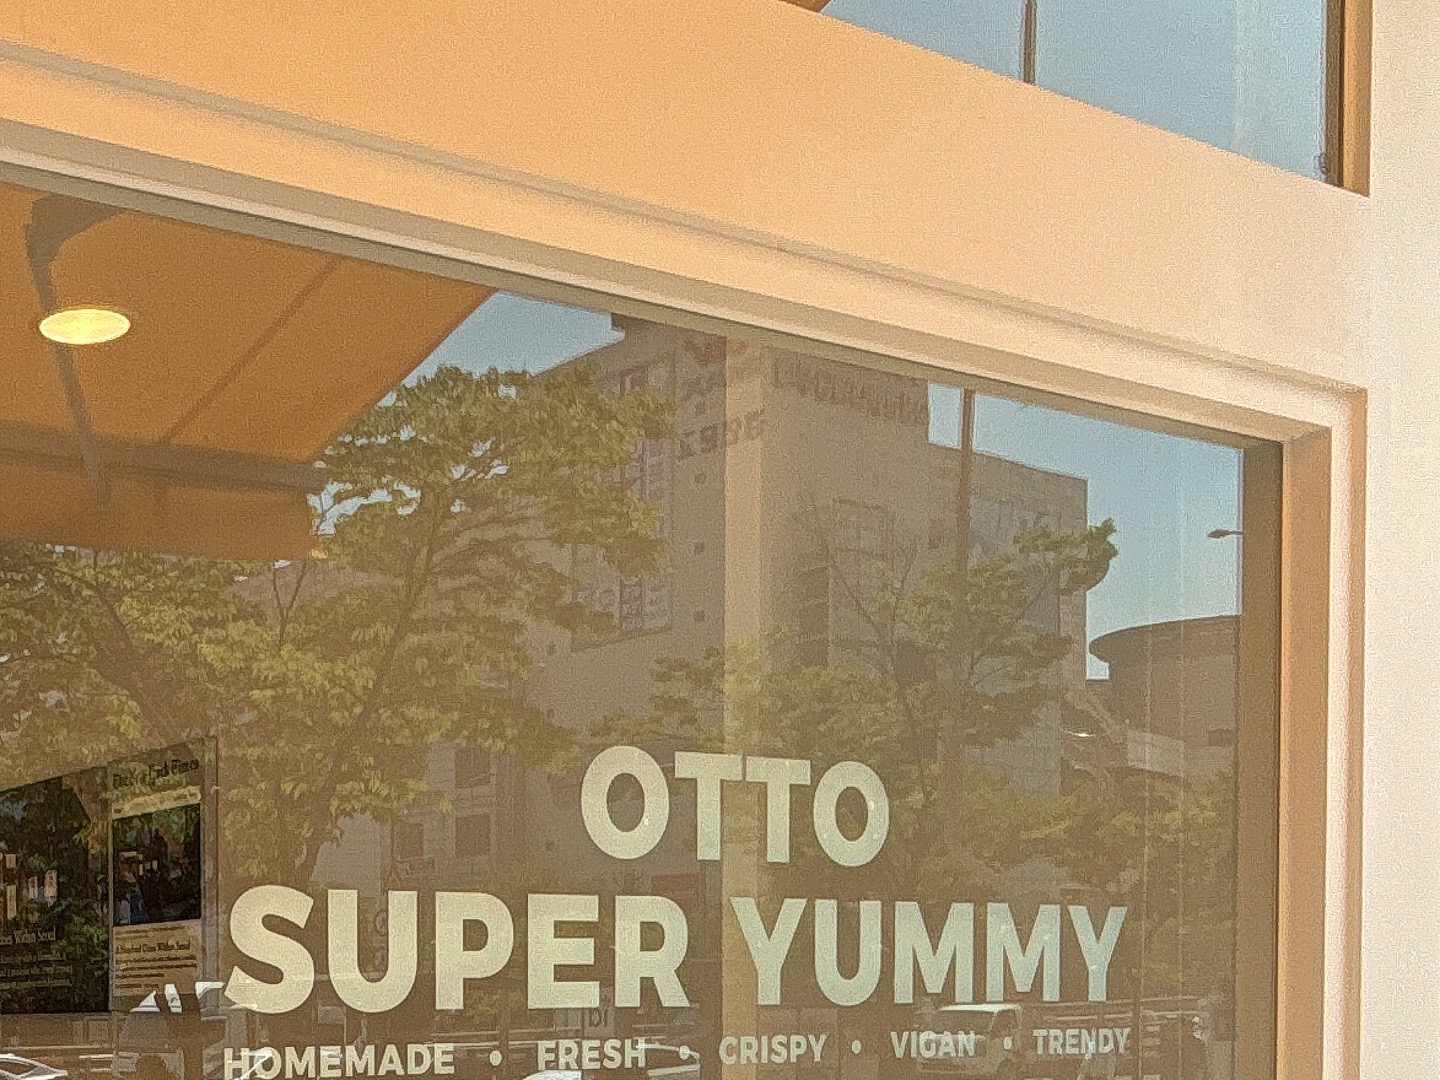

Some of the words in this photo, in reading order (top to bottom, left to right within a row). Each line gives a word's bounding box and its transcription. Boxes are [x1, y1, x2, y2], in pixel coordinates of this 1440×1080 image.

[581, 745, 890, 868] OTTO
[223, 884, 691, 1014] SUPER
[729, 896, 1128, 1007] YUMMY
[223, 1042, 455, 1080] HOMEMADE
[537, 1038, 647, 1071] FRESH
[718, 1033, 828, 1065] CRISPY
[891, 1030, 976, 1059] VIGAN
[1032, 1027, 1131, 1055] TRENDY
